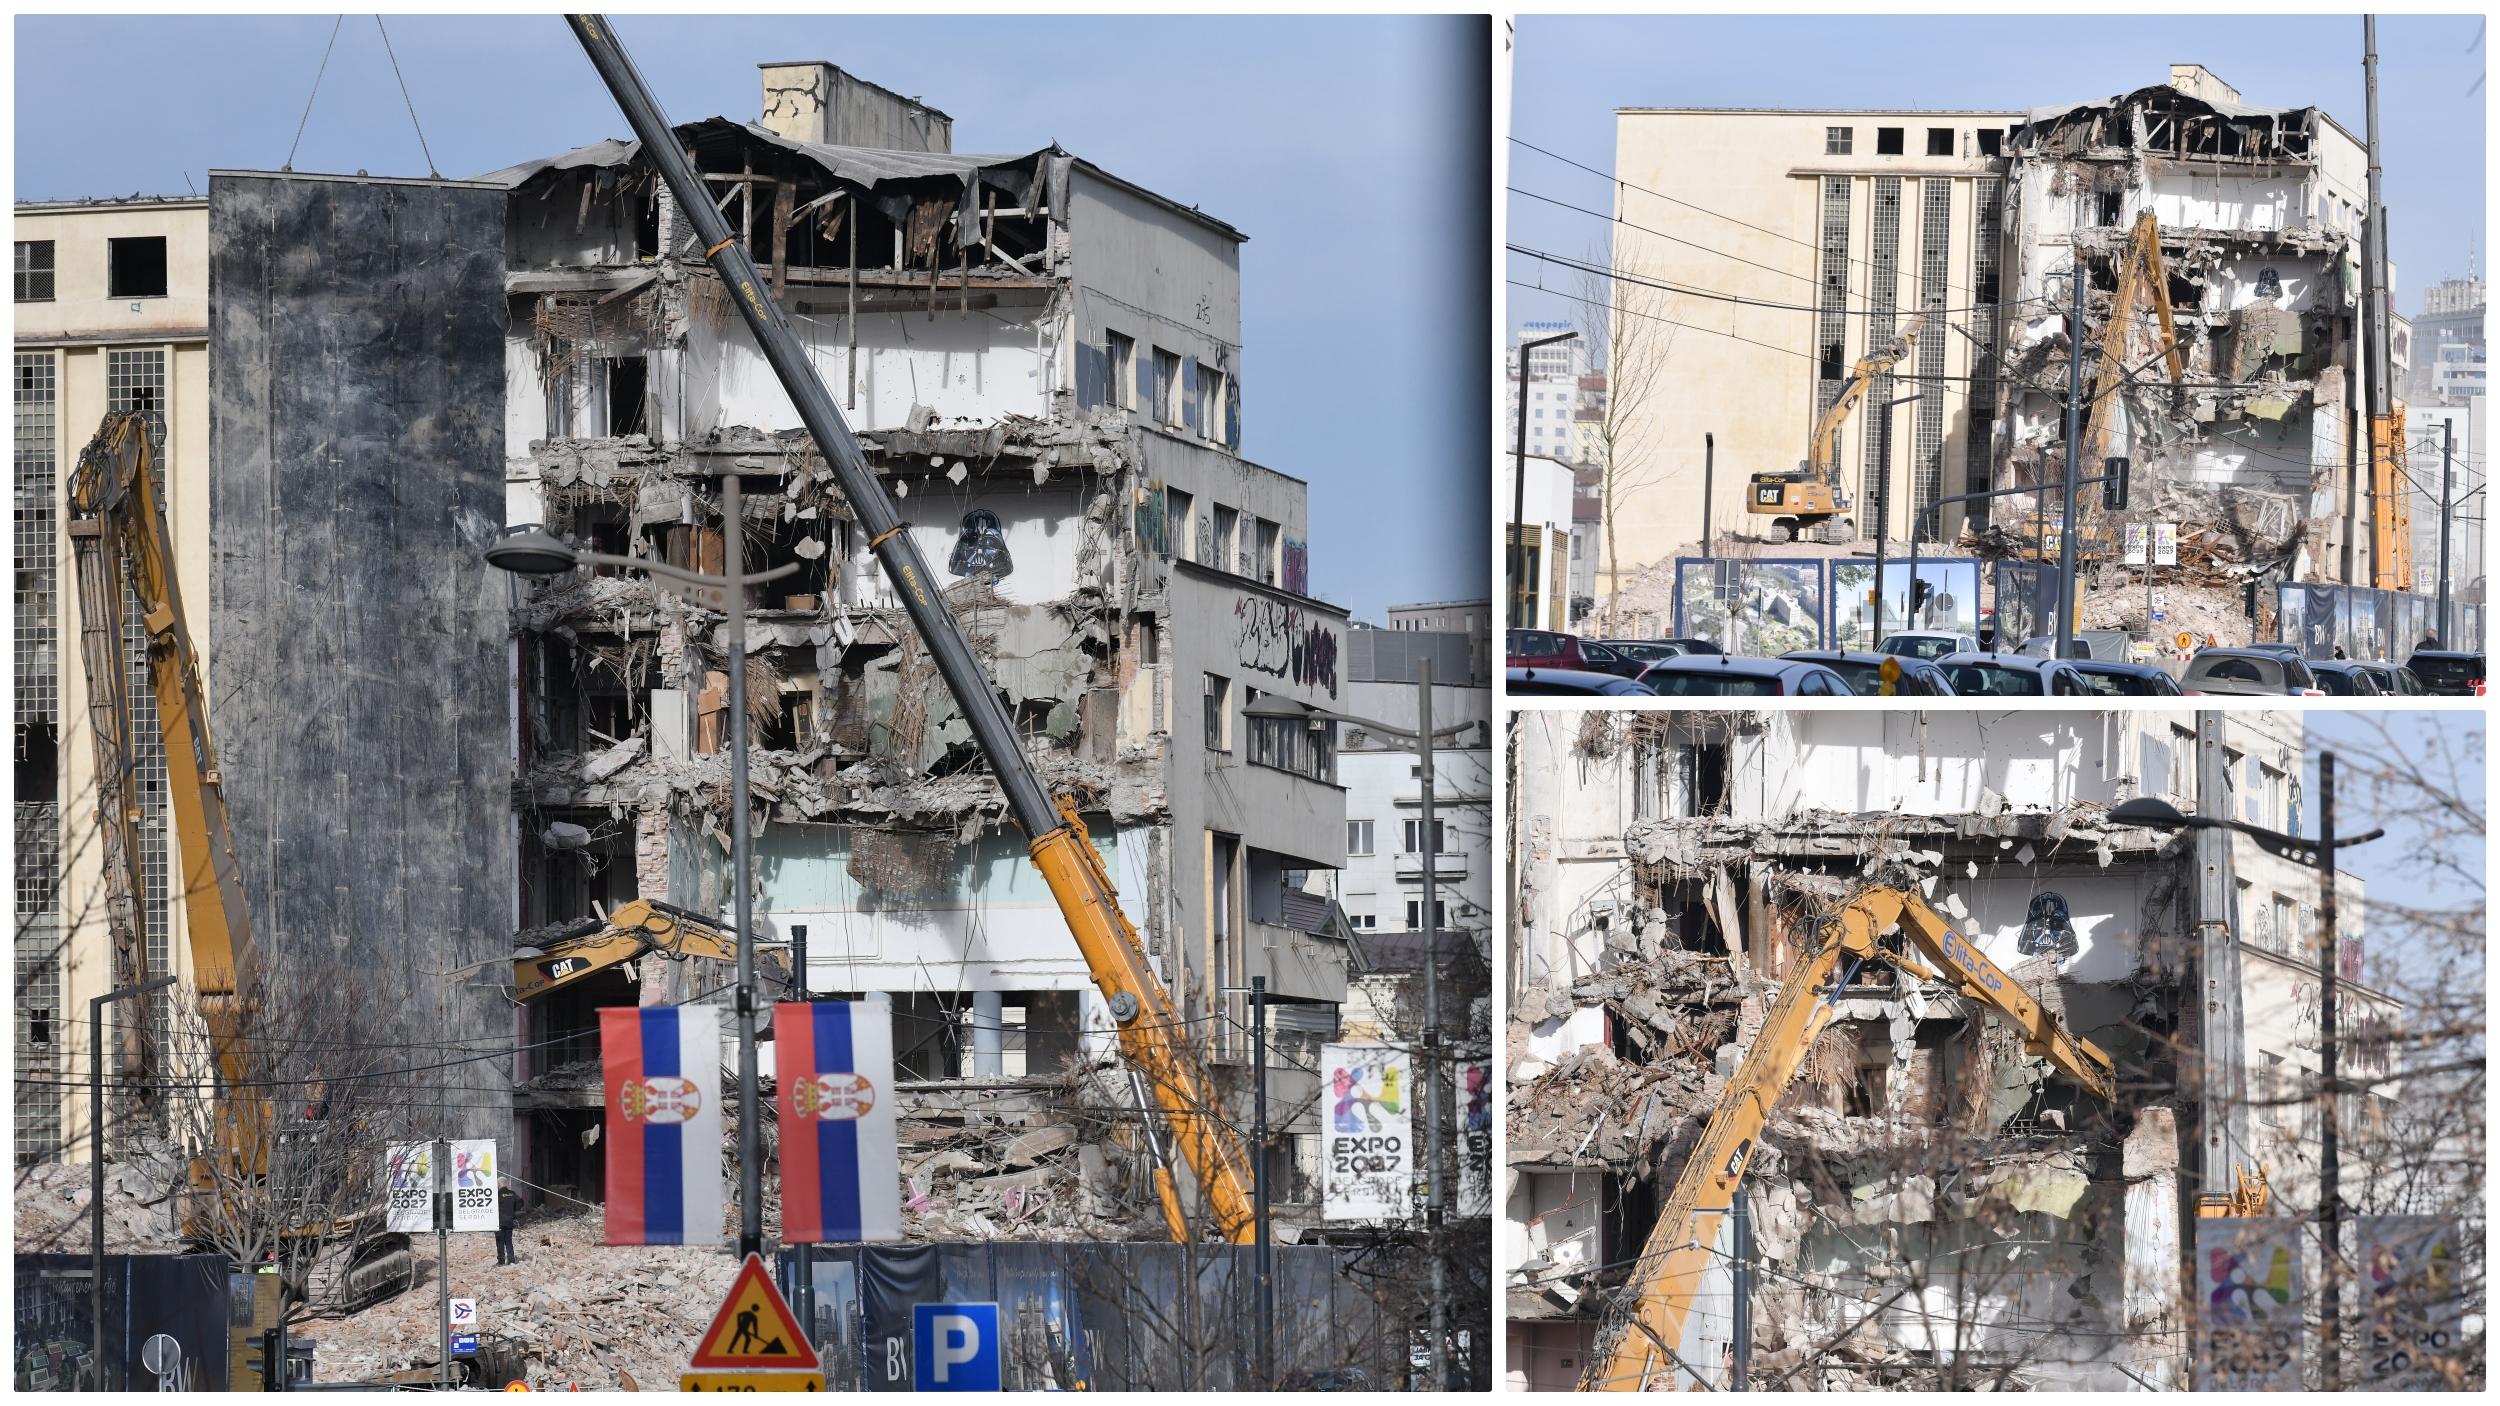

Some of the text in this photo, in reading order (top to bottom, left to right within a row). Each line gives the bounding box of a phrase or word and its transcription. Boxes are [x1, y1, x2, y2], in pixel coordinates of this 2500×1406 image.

[1760, 489, 1779, 503] CAT
[552, 958, 573, 979] CAT
[1334, 1136, 1402, 1154] EXPO
[1731, 1147, 1743, 1175] CAT
[392, 1189, 428, 1199] EXPO
[458, 1188, 493, 1198] EXPO
[392, 1199, 427, 1209] 2027
[458, 1198, 493, 1208] 2027
[933, 1315, 980, 1383] P
